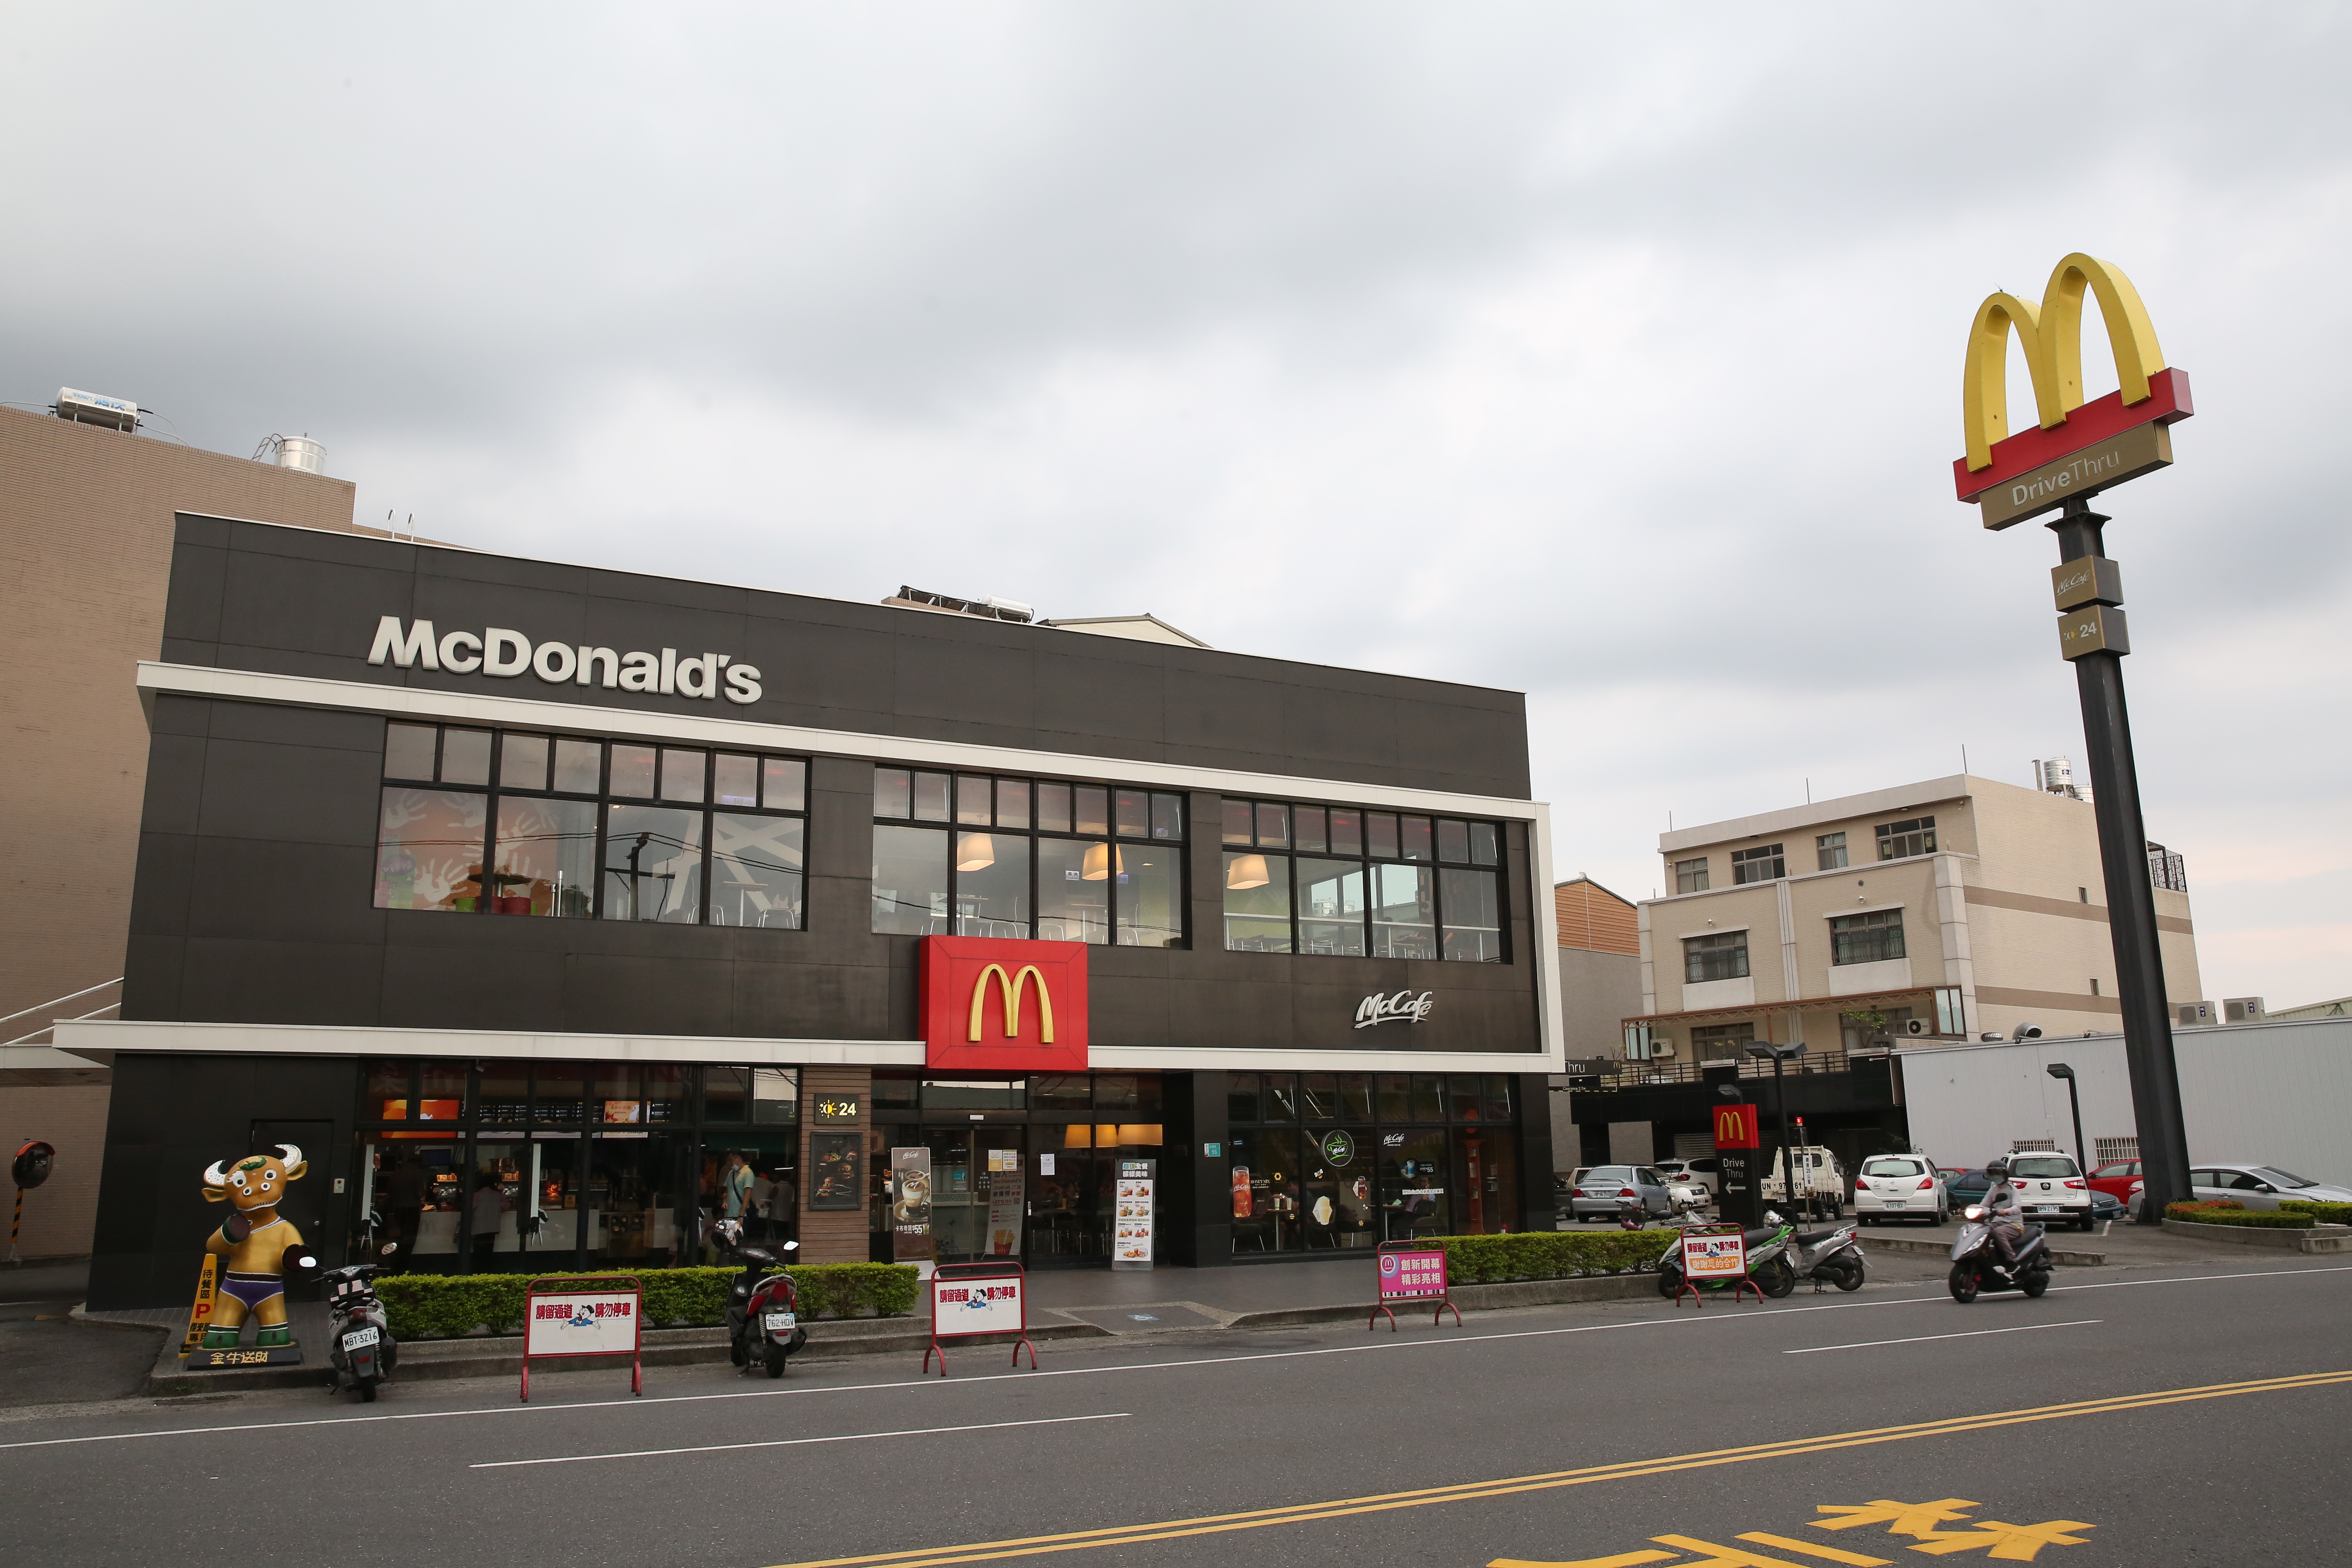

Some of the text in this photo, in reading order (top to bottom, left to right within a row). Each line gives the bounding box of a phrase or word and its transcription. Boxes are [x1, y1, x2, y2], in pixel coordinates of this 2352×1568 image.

[2080, 621, 2097, 638] 24
[367, 615, 762, 704] McDonald's
[1354, 989, 1433, 1029] McCafé
[839, 1102, 857, 1116] 24
[1383, 1133, 1404, 1145] McCafé
[1723, 1158, 1744, 1167] Drive
[1726, 1169, 1743, 1178] Thru
[1401, 1258, 1440, 1271] 創新開幕
[1692, 1258, 1738, 1269] 謝謝您的合作
[200, 1269, 213, 1299] 待餐區
[1401, 1273, 1440, 1285] 精彩亮相
[940, 1286, 1016, 1303] 請留通道 請勿停車
[196, 1303, 211, 1319] P
[536, 1302, 631, 1319] 請留通道 請勿停車
[344, 1332, 377, 1348] MBT-3216
[210, 1351, 269, 1364] 金牛送財
